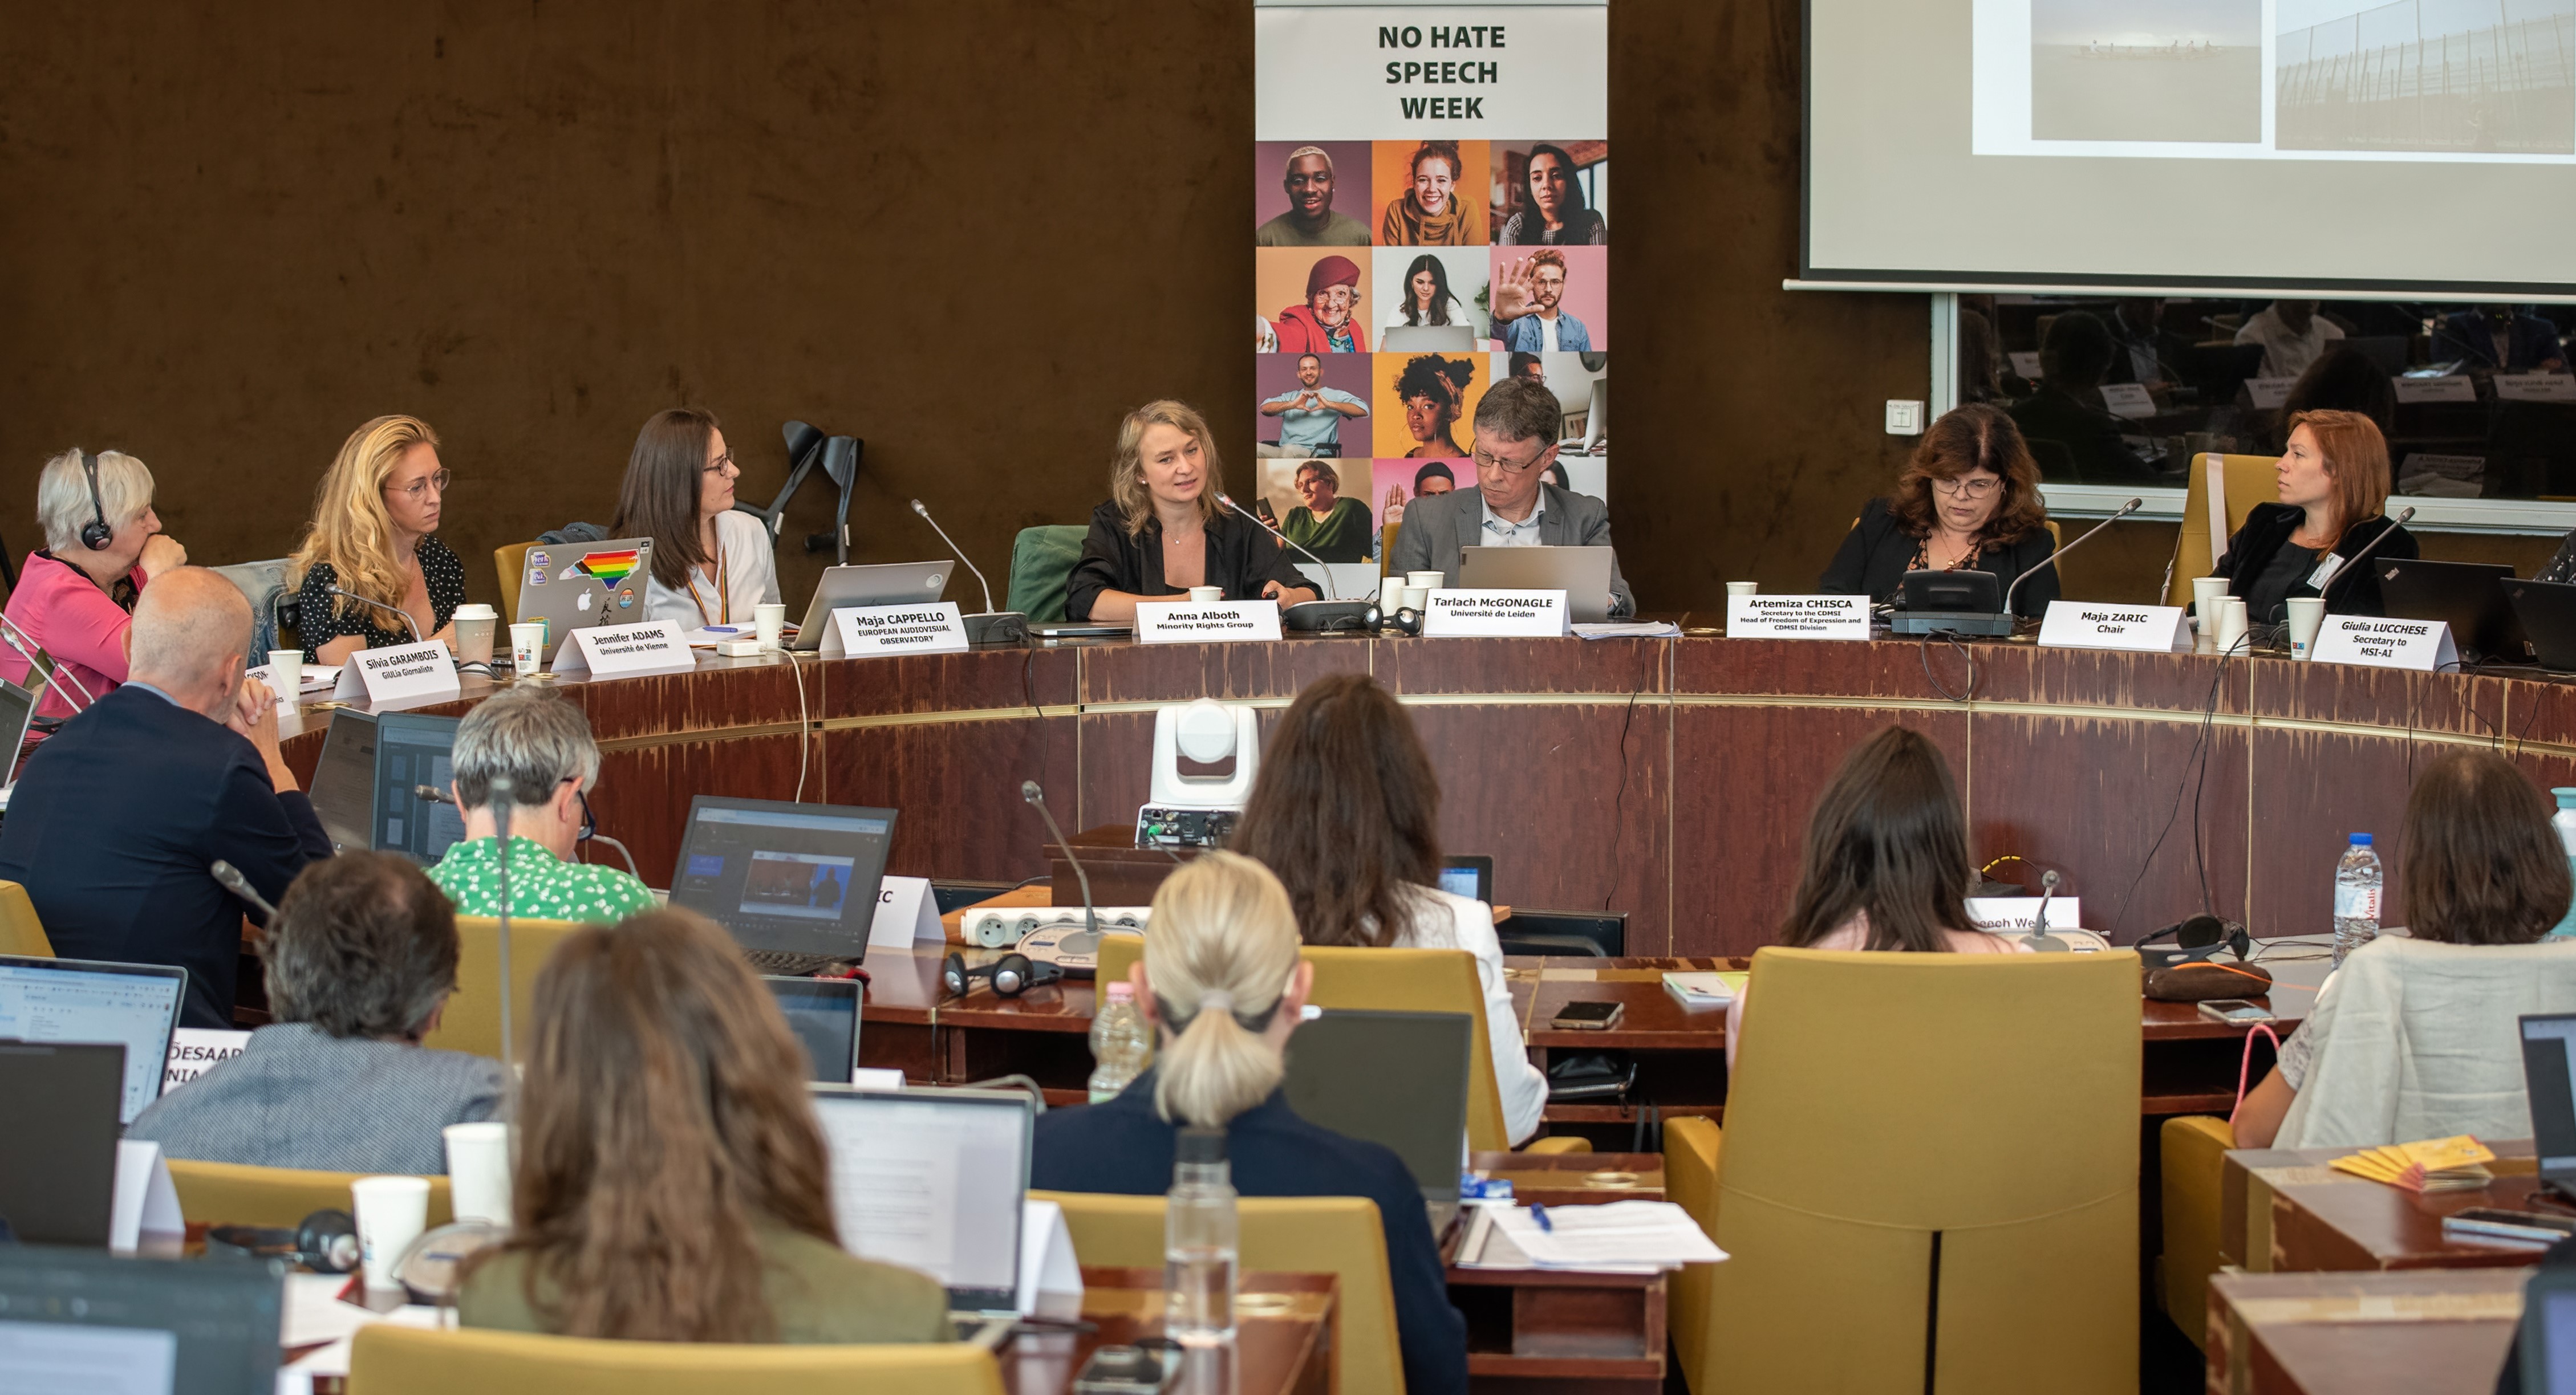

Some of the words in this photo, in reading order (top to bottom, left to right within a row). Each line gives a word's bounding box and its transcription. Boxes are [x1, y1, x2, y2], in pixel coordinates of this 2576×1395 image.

[1379, 26, 1422, 48] NO
[1431, 26, 1505, 48] HATE
[1386, 61, 1498, 84] SPEECH
[1401, 97, 1483, 119] WEEK
[1434, 597, 1476, 607] Tarlach
[1480, 598, 1553, 607] McGONAGLE
[1807, 600, 1852, 608] CHISCA
[856, 615, 885, 628] Maja
[887, 612, 945, 624] CAPPELLO
[1202, 611, 1240, 620] Alboth
[2081, 612, 2108, 623] Maja
[2111, 613, 2148, 623] ZARIC
[858, 628, 898, 637] EUROPEAN
[900, 624, 951, 635] AUDIOVISUAL
[2097, 625, 2125, 633] Chair
[2342, 621, 2371, 632] Giulia
[2373, 623, 2428, 636] LUCCHESE
[593, 633, 630, 645] Jennifer
[633, 629, 665, 642] ADAMS
[880, 635, 934, 645] OBSERVATORY
[2352, 635, 2395, 647] Secretary
[2397, 638, 2407, 646] to
[599, 644, 634, 655] Université
[646, 642, 668, 650] Vienne
[2360, 648, 2393, 658] MSI-AI
[366, 658, 390, 670] Silvia
[390, 649, 439, 666] GARAMBOIS
[403, 664, 433, 677] Giornaliste
[2015, 918, 2051, 928] Wek
